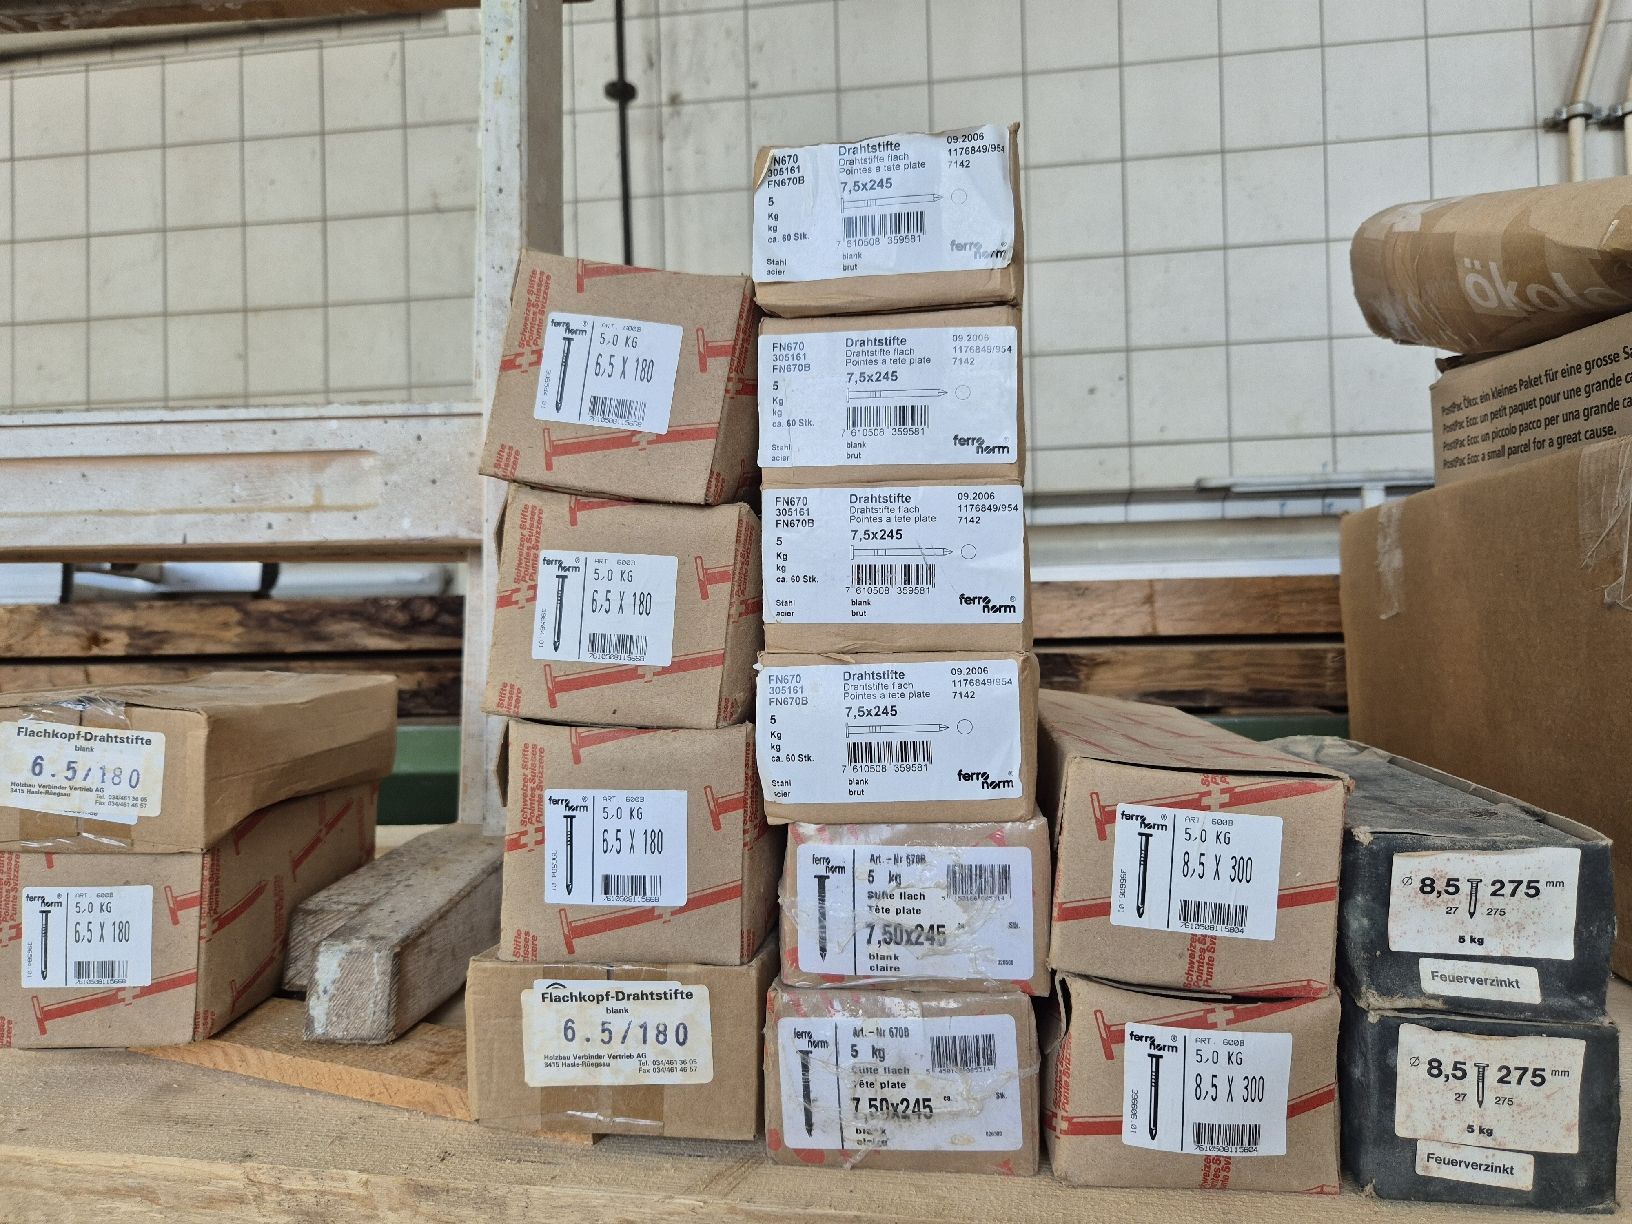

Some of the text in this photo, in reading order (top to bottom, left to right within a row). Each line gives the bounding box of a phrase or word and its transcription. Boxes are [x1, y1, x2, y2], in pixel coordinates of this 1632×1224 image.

[946, 132, 984, 144] 09.2006
[838, 141, 900, 157] Drahtstifte
[948, 160, 970, 169] 7142
[767, 165, 800, 177] 305161
[767, 176, 805, 188] FN670B
[840, 178, 893, 194] 7,5x245
[768, 197, 774, 206] 5
[768, 224, 778, 233] kg
[843, 264, 857, 272] brut
[599, 333, 638, 349] 5,0 KG
[846, 337, 906, 348] Drahtstifte
[772, 342, 804, 352] FN670
[772, 353, 806, 362] 305161
[594, 353, 654, 383] 6,5 X 180
[772, 364, 811, 374] FN670B
[1519, 351, 1619, 391] Paket für eine grosse
[847, 371, 898, 384] 7,5x245
[772, 381, 779, 391] 5
[1539, 373, 1621, 409] pour une grande
[772, 397, 783, 407] Kg
[1519, 398, 1619, 433] pacco per una grande
[953, 434, 985, 447] ferro
[1508, 425, 1616, 459] parcel for a great cause.
[847, 451, 861, 460] brut
[849, 493, 911, 504] Drahtstifte
[957, 492, 995, 500] 09.2006
[775, 497, 808, 507] FN670
[957, 503, 1019, 512] 1176849/954
[775, 507, 810, 517] 305161
[775, 519, 815, 528] FN670B
[915, 515, 937, 524] plate
[957, 516, 981, 524] 7142
[851, 529, 903, 542] 7,5x245
[776, 537, 782, 546] 5
[542, 557, 564, 566] ferro
[776, 552, 788, 561] Kg
[558, 563, 580, 573] norm
[776, 564, 786, 574] kg
[593, 568, 633, 582] 5,0 KG
[803, 575, 819, 583] Stk.
[591, 590, 652, 616] 6,5 X 180
[959, 594, 991, 605] ferro
[982, 604, 1016, 614] norm
[843, 671, 905, 681] Drahtstifte
[951, 667, 988, 676] 09.2006
[768, 674, 801, 684] FN670
[768, 686, 804, 695] 305161
[909, 691, 931, 700] plate
[952, 691, 975, 699] 7142
[768, 696, 808, 705] FN670B
[845, 705, 898, 718] 7,5x245
[770, 715, 776, 724] 5
[17, 727, 151, 746] Flachkopf-Drahtstifte
[770, 731, 782, 741] Kg
[520, 742, 530, 770] Stifte
[957, 769, 990, 782] ferro
[71, 785, 94, 793] Vertrieb
[982, 779, 1014, 790] norm
[848, 788, 865, 796] brut
[548, 795, 570, 806] ferro
[536, 793, 545, 823] Punte
[565, 802, 588, 813] norm
[602, 806, 643, 820] 5,0 KG
[1121, 811, 1147, 821] ferro
[1139, 820, 1167, 832] norm
[602, 828, 664, 855] 6,5 X 180
[1184, 827, 1231, 845] 5,0 KG
[1182, 851, 1253, 883] 8,5 X 300
[868, 870, 901, 886] 5 kg
[1419, 877, 1565, 898] 8,5 275 mm
[26, 893, 45, 902] ferro
[40, 900, 62, 908] norm
[75, 902, 111, 913] 5,0 KG
[896, 906, 921, 916] plate
[1446, 907, 1506, 916] 27 275
[74, 921, 130, 943] 6,5 X 180
[1458, 935, 1484, 945] 5 kg
[870, 964, 900, 972] claire
[1431, 971, 1521, 989] Feuerverzinkt
[541, 988, 694, 1005] Flachkopf-Drahtstifte
[606, 1006, 629, 1014] blank
[1129, 1031, 1156, 1043] ferro
[851, 1044, 886, 1061] 5 kg
[1149, 1040, 1178, 1054] norm
[1195, 1049, 1243, 1066] 5,0 KG
[1427, 1058, 1570, 1087] 8,5 275 mm
[880, 1080, 906, 1090] plate
[1194, 1072, 1265, 1103] 8,5 X 300
[1455, 1093, 1514, 1106] 27 275
[1467, 1124, 1493, 1137] 5 kg
[1426, 1152, 1514, 1176] Feuerverzinkt
